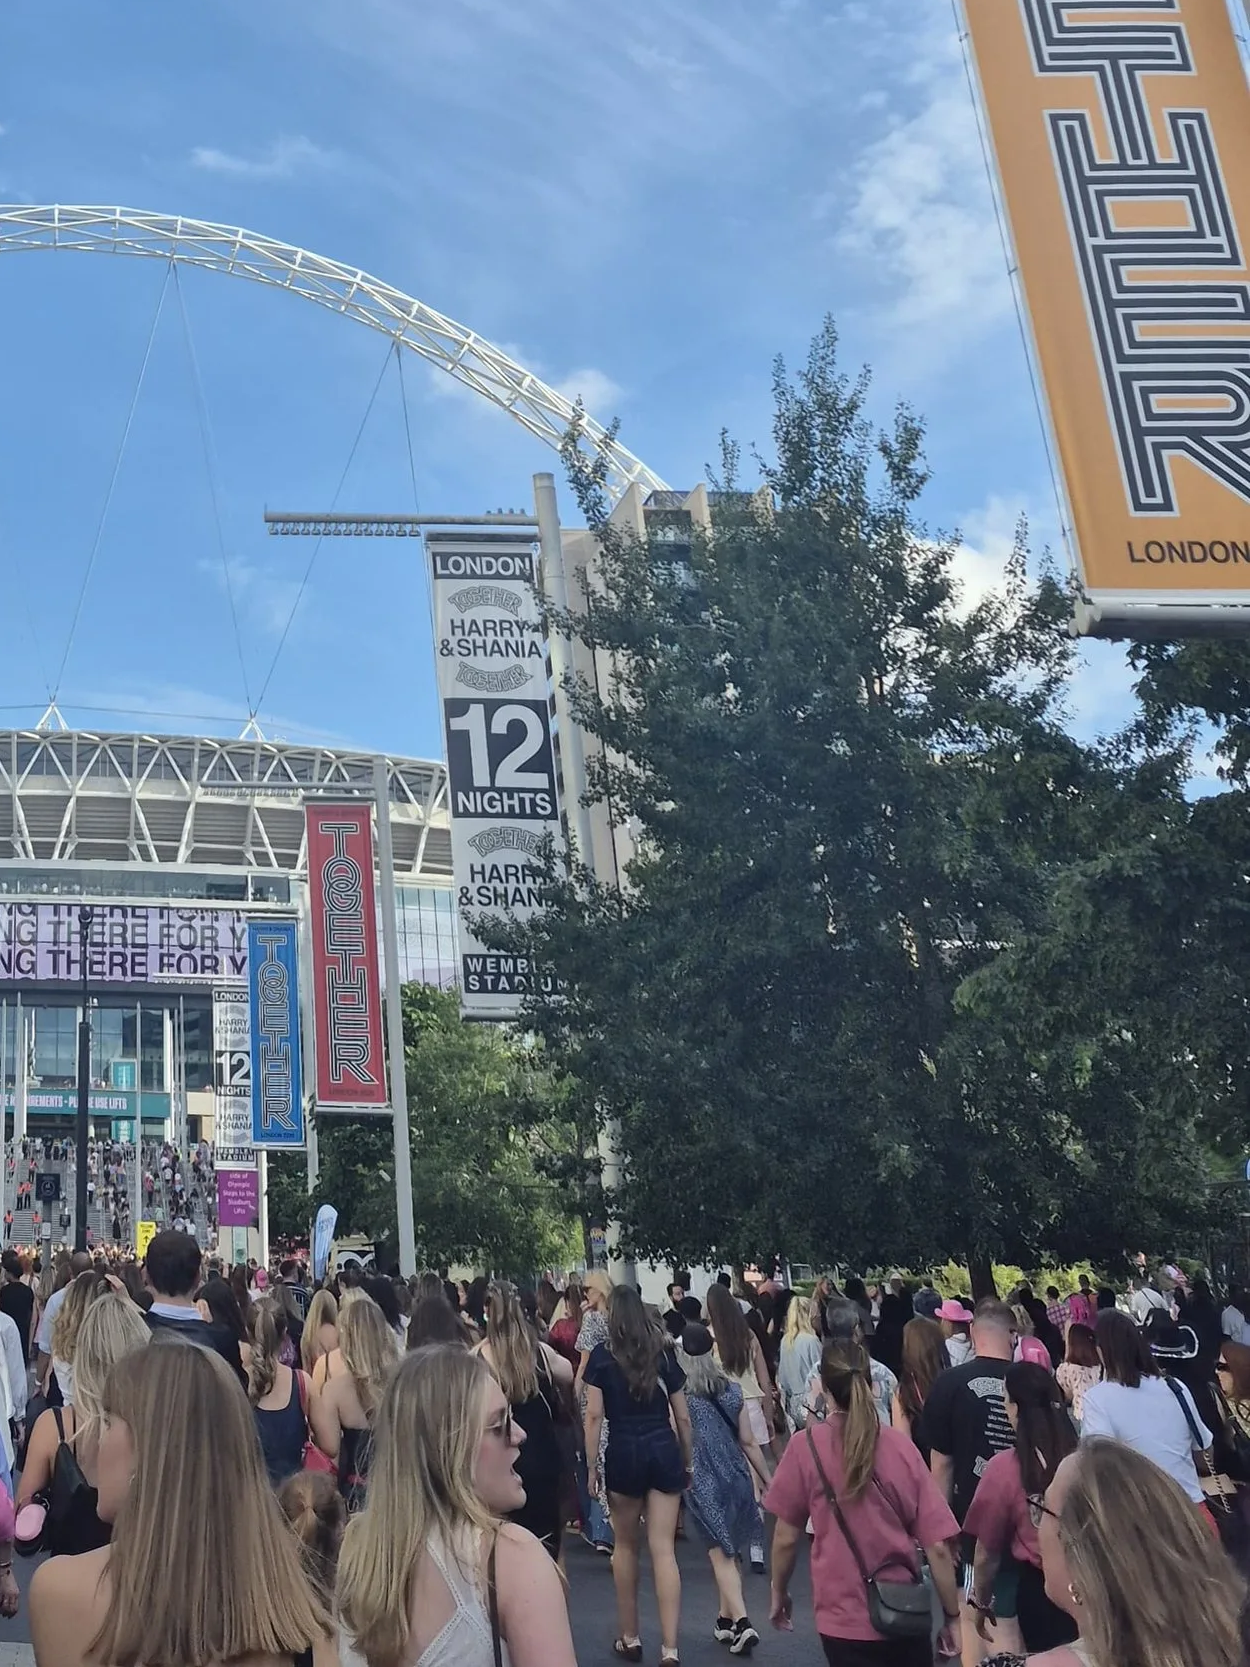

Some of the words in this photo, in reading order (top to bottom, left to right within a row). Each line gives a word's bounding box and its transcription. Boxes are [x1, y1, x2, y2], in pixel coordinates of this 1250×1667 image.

[1127, 540, 1250, 563] LONDON
[435, 556, 530, 576] LONDON
[447, 585, 523, 617] TOGETHER
[450, 619, 529, 638] HARRY
[455, 661, 534, 692] TOGETHER
[449, 703, 550, 789] 12
[457, 791, 552, 815] NIGHTS
[476, 886, 550, 907] SHAN
[47, 920, 149, 948] THERE
[159, 923, 219, 952] FOR
[46, 949, 149, 977] THERE
[158, 953, 219, 975] FOR
[319, 821, 380, 1085] TOGETHER
[215, 992, 249, 1001] LONDON
[257, 936, 298, 1130] TOGETHER
[216, 1052, 250, 1085] 12
[217, 1085, 250, 1095] NIGHTS
[95, 1097, 108, 1109] USE
[109, 1098, 127, 1110] LIFTS
